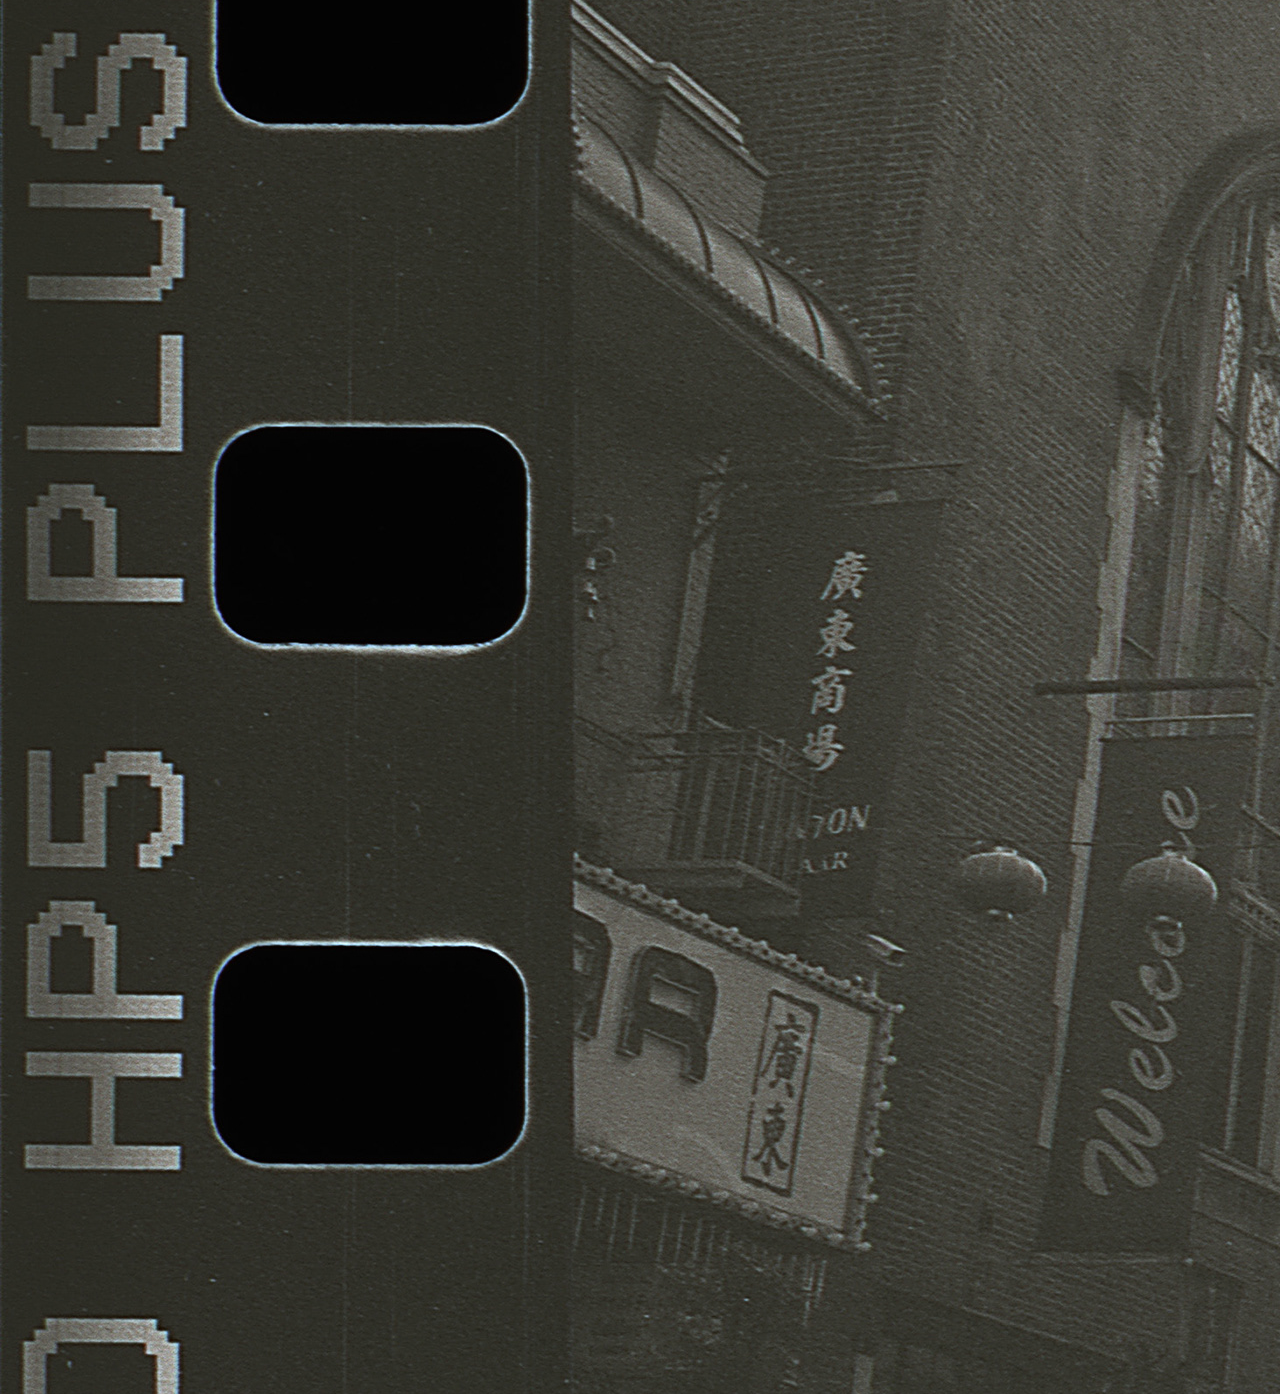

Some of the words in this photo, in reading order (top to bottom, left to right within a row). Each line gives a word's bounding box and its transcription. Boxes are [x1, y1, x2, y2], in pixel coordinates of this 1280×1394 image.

[26, 33, 187, 603] PLUS
[25, 750, 184, 1170] HP5
[1083, 785, 1200, 1197] Welcoe
